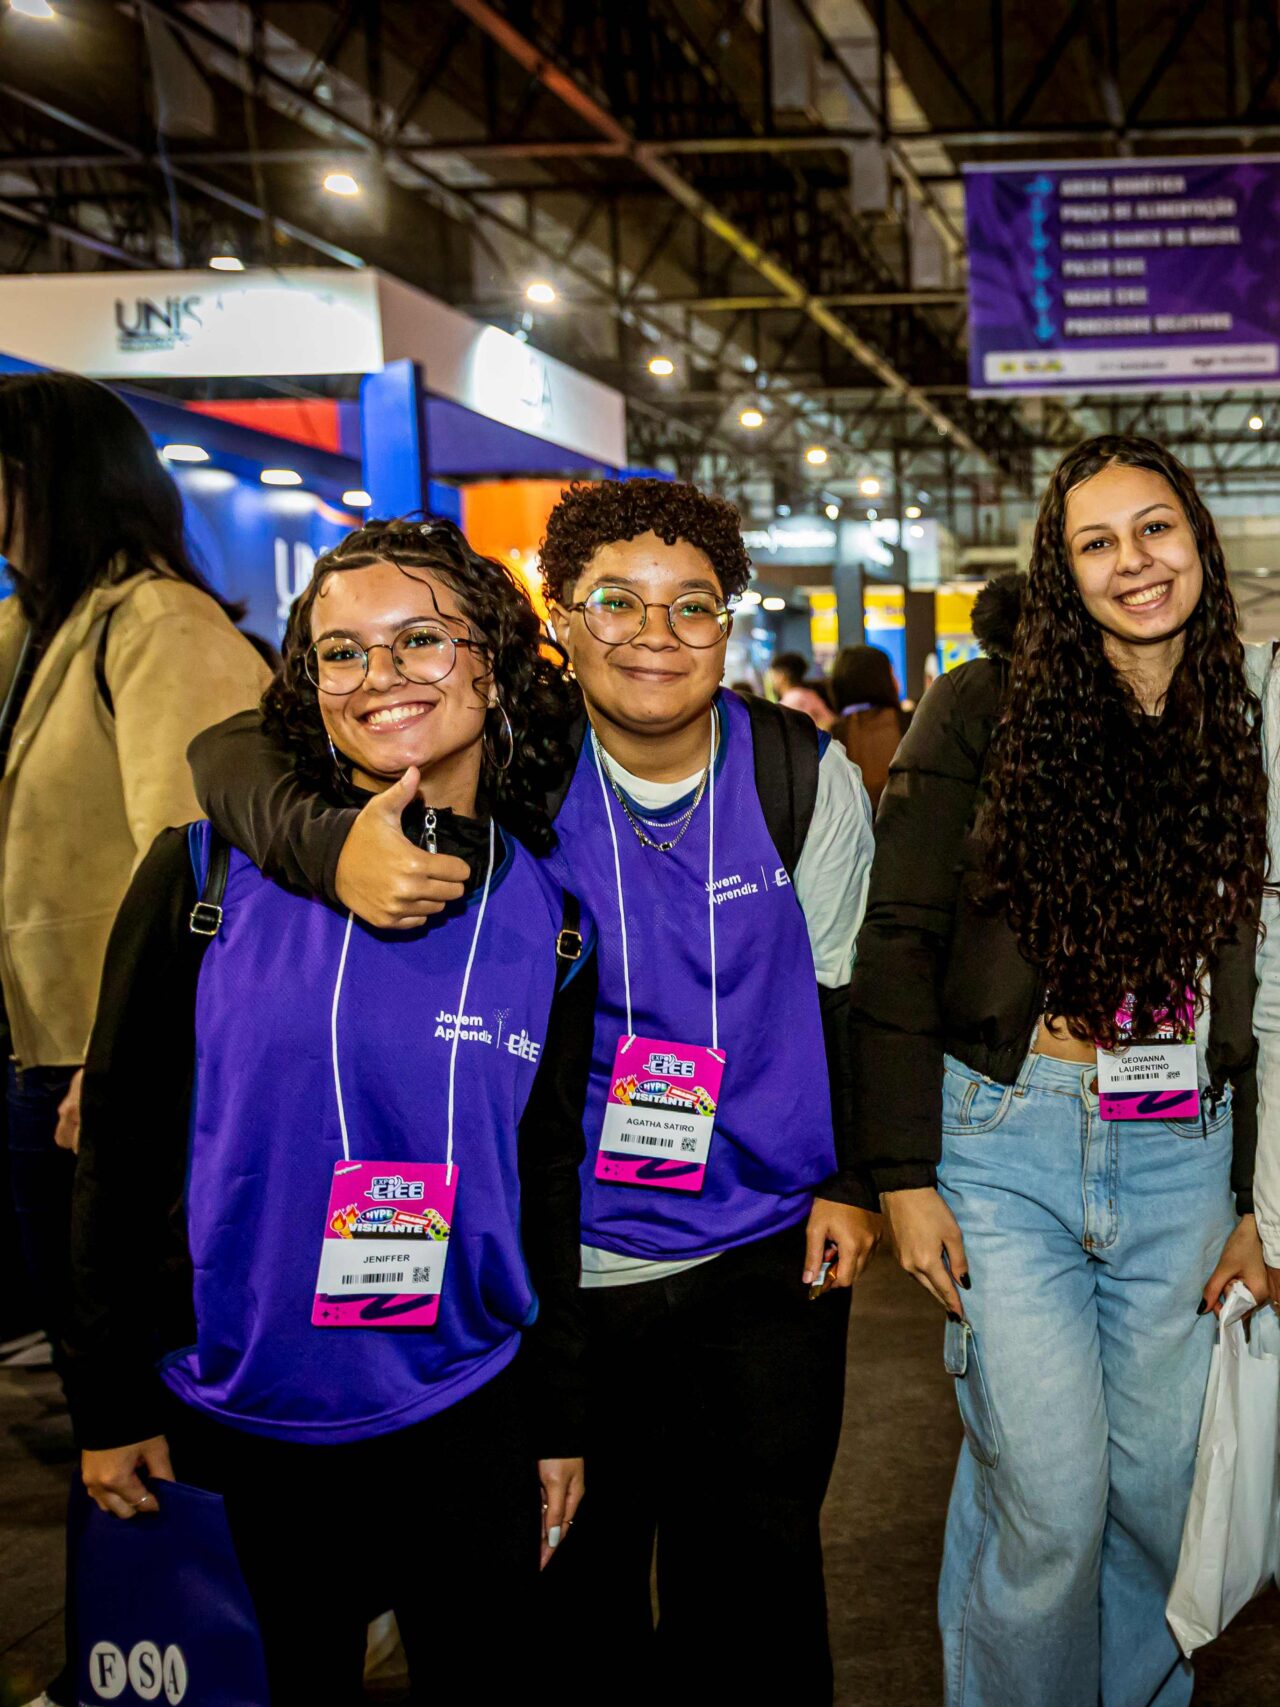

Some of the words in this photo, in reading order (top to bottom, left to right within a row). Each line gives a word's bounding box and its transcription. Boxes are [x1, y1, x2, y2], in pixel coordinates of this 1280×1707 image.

[435, 1010, 483, 1026] Jovem
[1121, 1055, 1165, 1065] GEOVANNA
[1119, 1063, 1170, 1073] LAURENTINO
[629, 1092, 693, 1108] VISITANTE
[626, 1117, 662, 1129] AGATHA
[663, 1122, 695, 1133] SATIRO
[366, 1209, 394, 1220] HYPE
[348, 1223, 423, 1233] VISITANTE
[363, 1254, 411, 1264] JENIFFER
[96, 1651, 180, 1695] FSA
